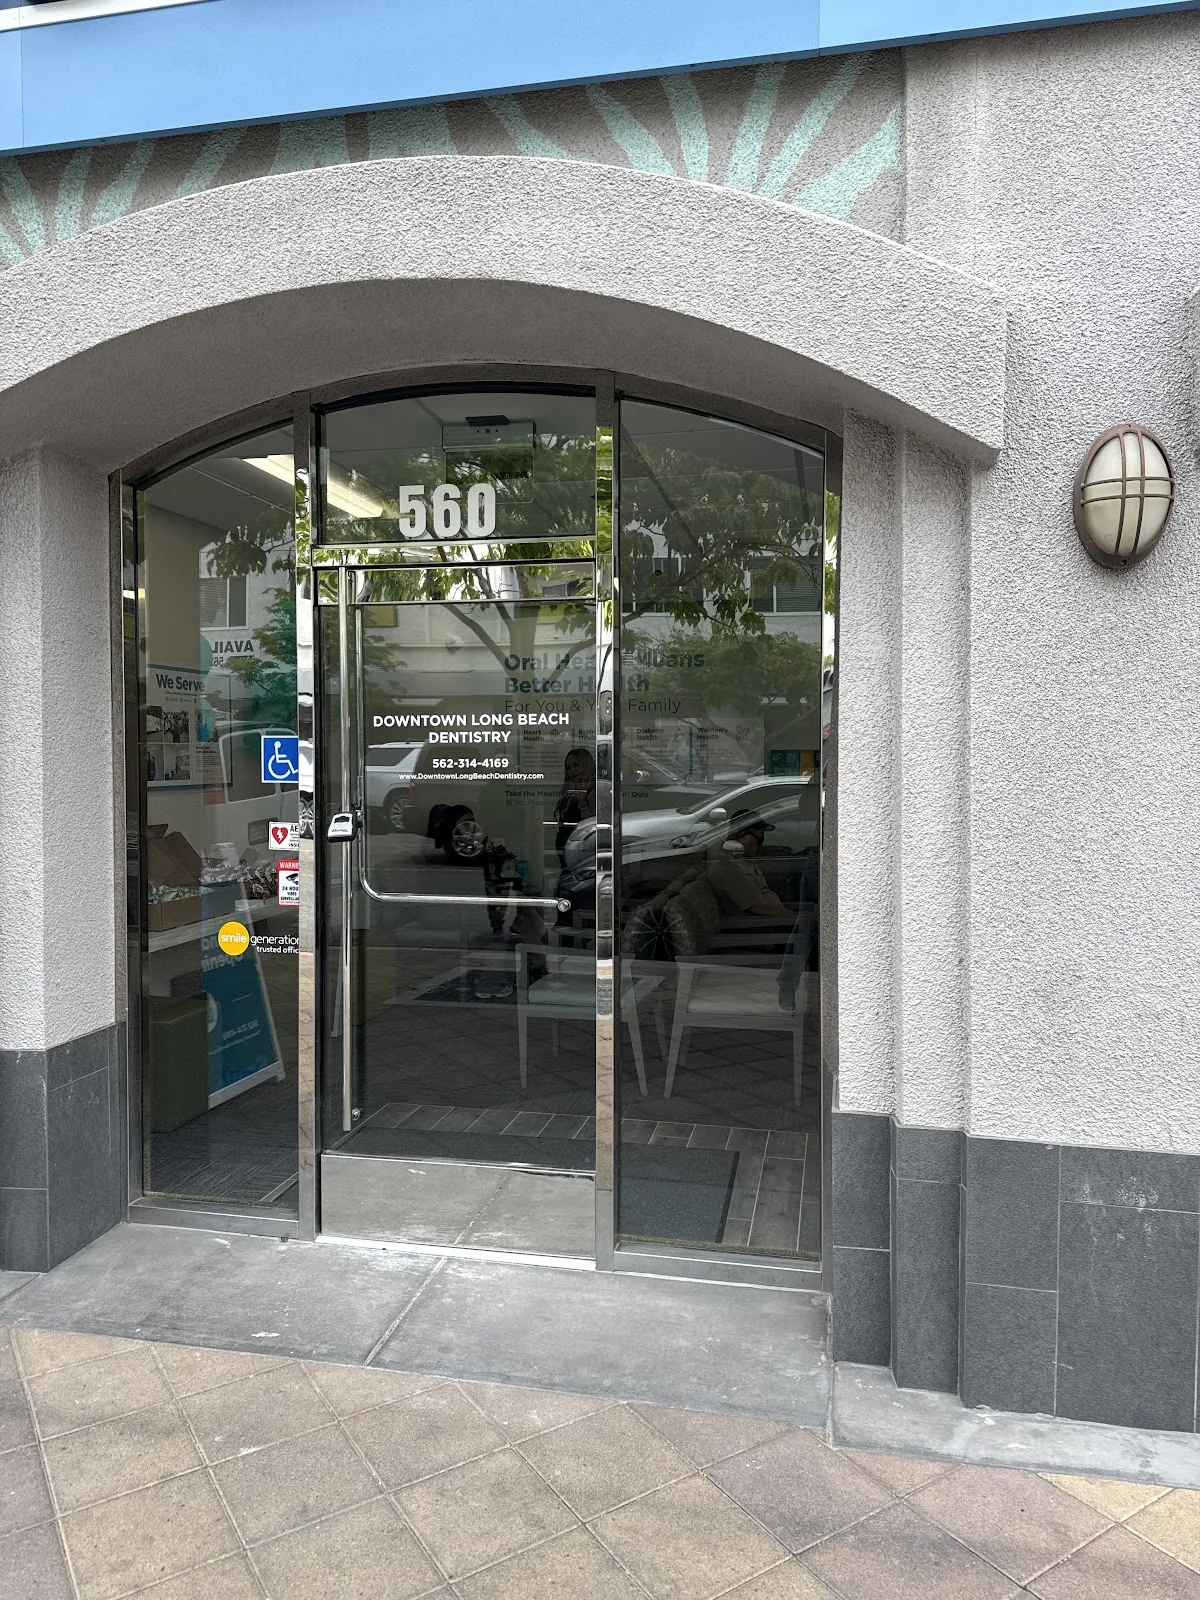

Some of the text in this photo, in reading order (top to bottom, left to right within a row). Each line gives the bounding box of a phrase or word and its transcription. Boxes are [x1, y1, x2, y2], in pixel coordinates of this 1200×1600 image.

[399, 483, 496, 538] 560
[504, 654, 548, 670] Oral
[155, 673, 205, 692] We Serve
[504, 677, 571, 693] Better
[505, 700, 531, 712] For
[536, 700, 565, 712] You
[571, 699, 581, 712] &
[628, 698, 681, 714] Family
[373, 713, 570, 727] DOWNTOWN LONG BEACH
[428, 731, 511, 743] DENTISTRY
[432, 758, 509, 769] 562-314-4169
[398, 773, 545, 782] www.DowntownLongBeachDentistry.com
[631, 791, 649, 799] Quiz
[290, 825, 299, 833] AE
[279, 861, 299, 869] WARNI
[220, 932, 248, 943] smile
[256, 946, 299, 954] trusted offic
